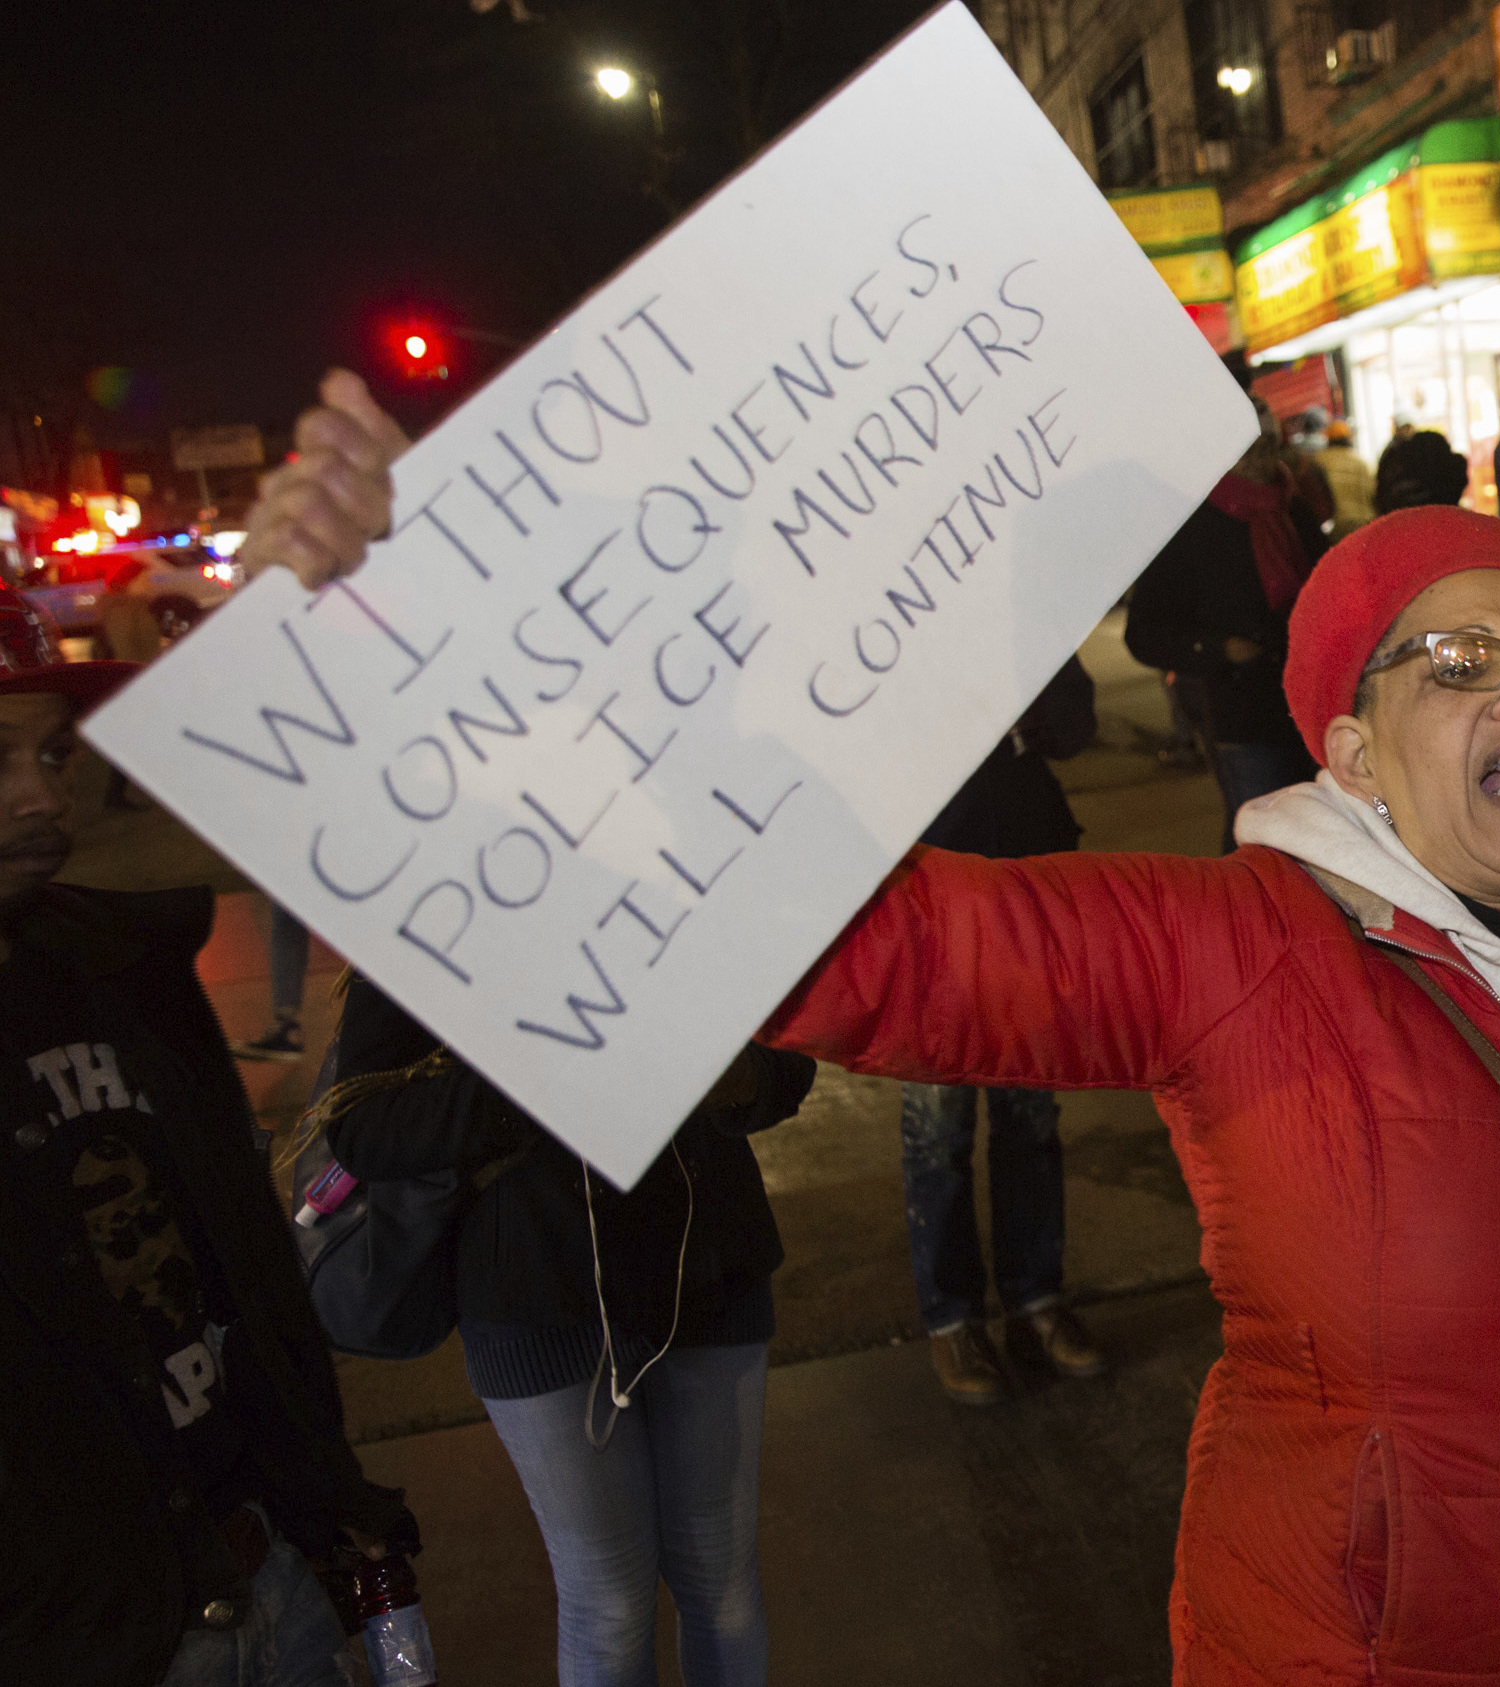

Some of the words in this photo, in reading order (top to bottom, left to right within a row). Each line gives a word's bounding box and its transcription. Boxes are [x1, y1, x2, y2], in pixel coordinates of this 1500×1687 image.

[181, 295, 694, 787] WITHOUT
[308, 215, 960, 903] CONSEQUENCES,
[396, 581, 771, 986] POLICE
[772, 260, 1044, 578] MURDERS
[515, 781, 803, 1054] WILL
[808, 389, 1077, 719] CONTINUE
[24, 1041, 153, 1128] TH
